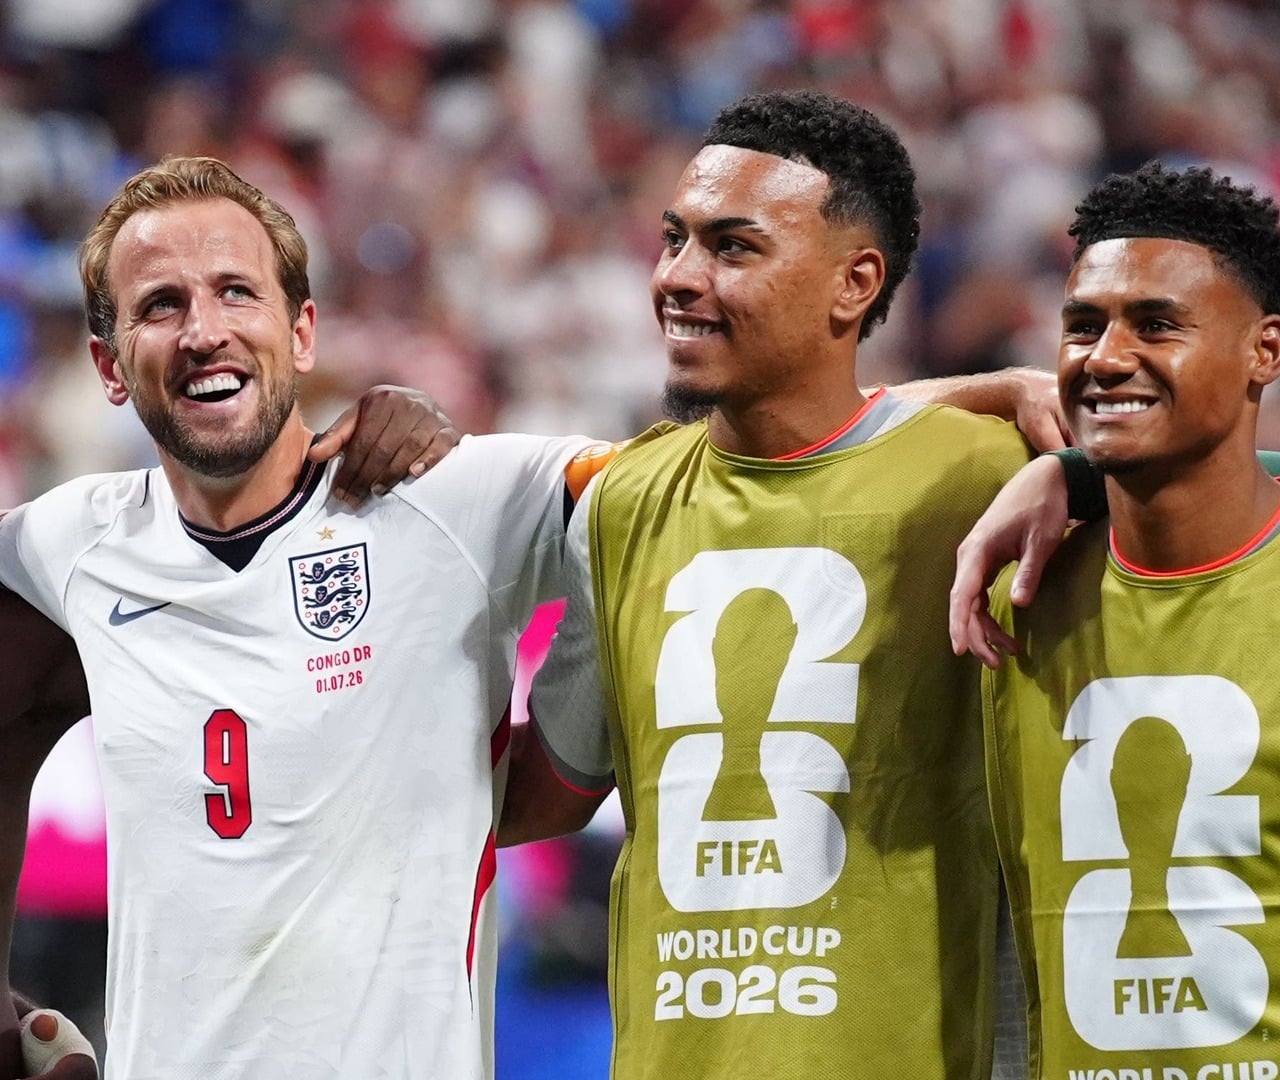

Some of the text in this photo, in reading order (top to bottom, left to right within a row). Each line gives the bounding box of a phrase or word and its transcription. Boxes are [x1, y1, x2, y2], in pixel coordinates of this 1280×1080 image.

[307, 645, 372, 672] CONGO DR
[316, 670, 363, 694] 01.07.26
[203, 708, 252, 839] 9
[696, 840, 783, 876] FIFA
[656, 924, 841, 963] WORLD CUP
[655, 964, 838, 1021] 2026
[1113, 976, 1208, 1015] FIFA
